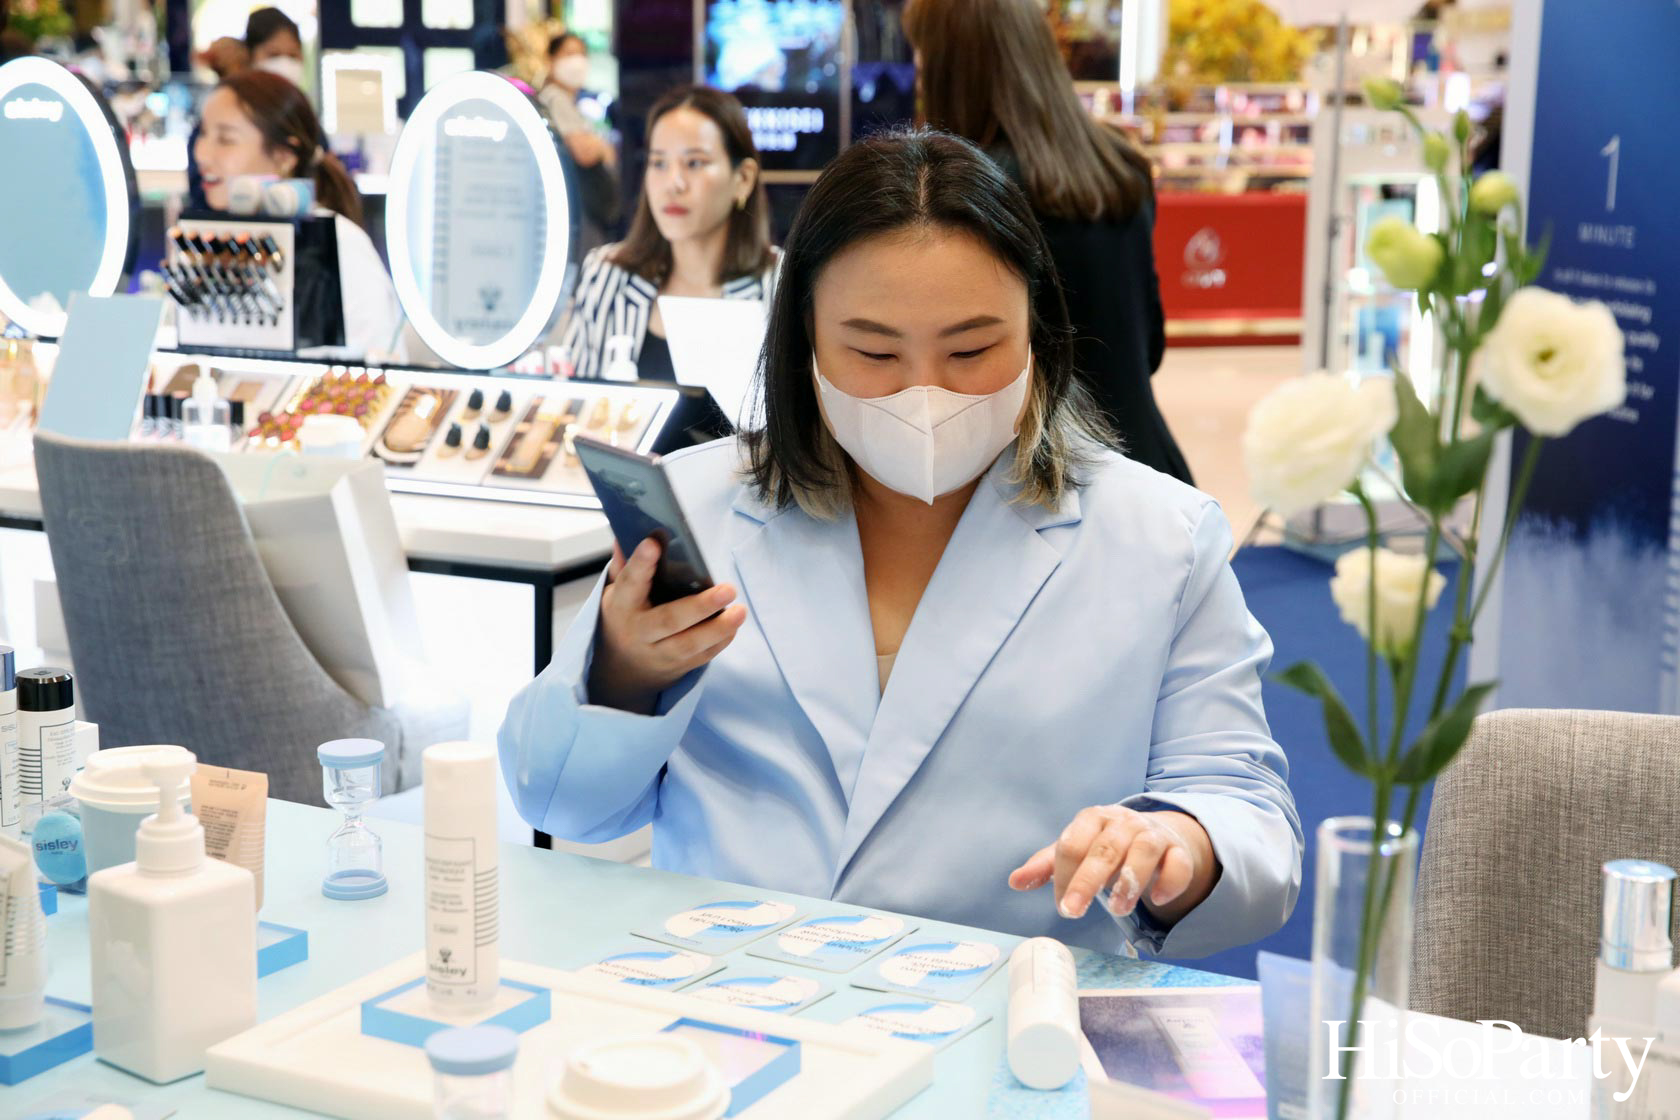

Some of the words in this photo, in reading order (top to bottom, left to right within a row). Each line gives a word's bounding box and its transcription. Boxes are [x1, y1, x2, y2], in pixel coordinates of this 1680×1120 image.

[1600, 134, 1620, 213] 1
[1578, 223, 1636, 249] MINUTE
[35, 838, 78, 852] sisley
